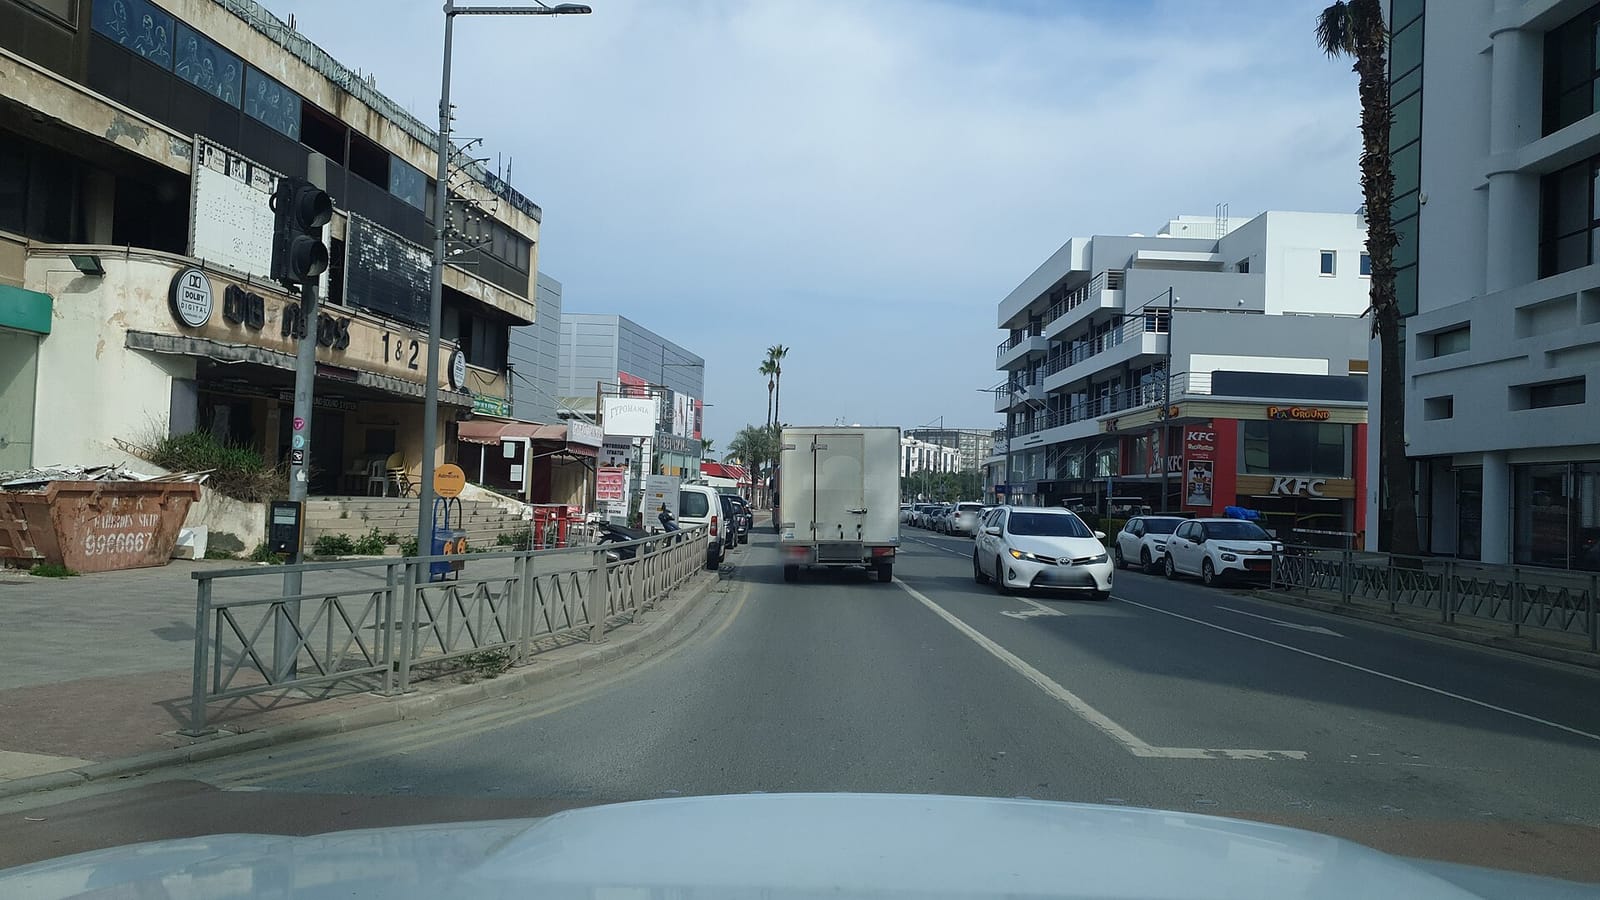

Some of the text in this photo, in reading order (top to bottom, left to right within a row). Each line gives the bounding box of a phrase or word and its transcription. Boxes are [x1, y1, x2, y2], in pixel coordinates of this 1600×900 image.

[185, 290, 205, 302] DOLBY
[180, 302, 207, 314] DIGITAL
[382, 331, 390, 364] 1
[394, 339, 402, 361] &
[408, 340, 420, 370] 2
[1187, 431, 1215, 442] KFC
[1167, 454, 1183, 472] KFC
[1270, 477, 1327, 497] KFC
